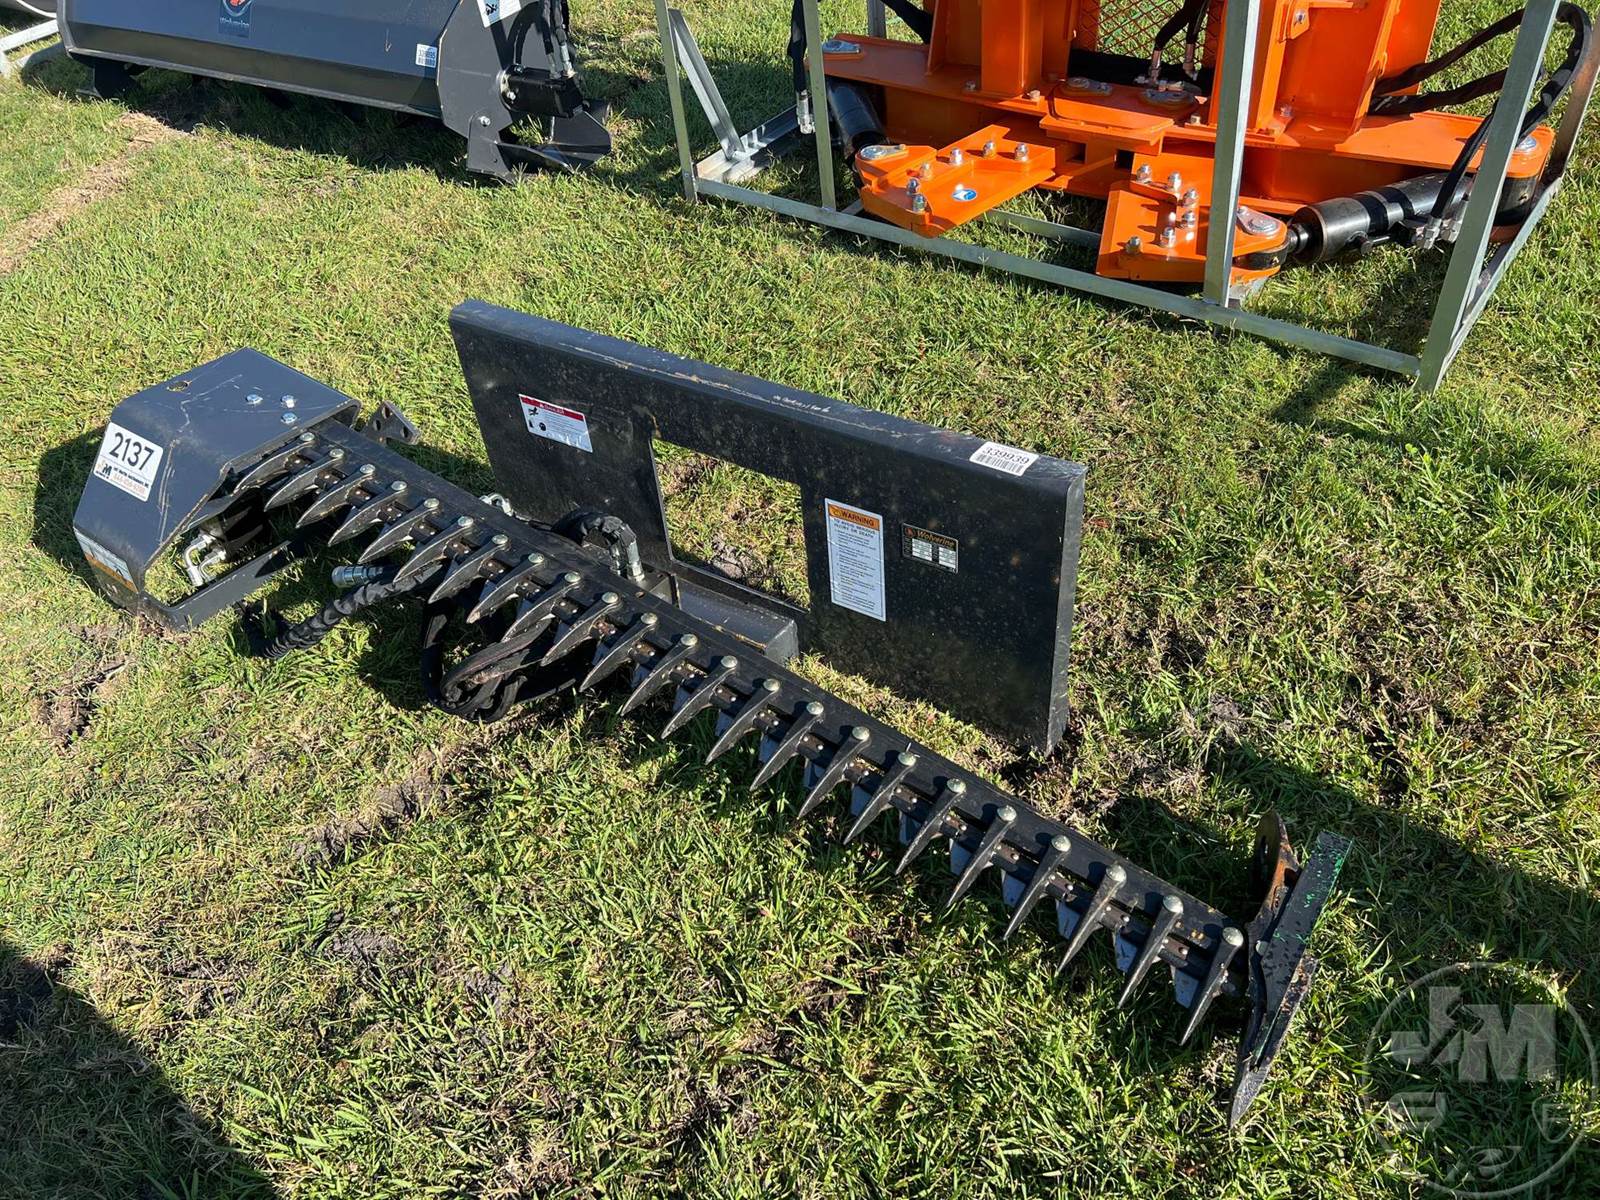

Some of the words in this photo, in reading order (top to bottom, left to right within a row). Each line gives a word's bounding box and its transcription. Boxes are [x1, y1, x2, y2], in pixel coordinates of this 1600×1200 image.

[109, 432, 155, 471] 2137
[982, 446, 1030, 465] 339939
[841, 510, 875, 527] WARNING
[917, 530, 955, 547] Wolverine
